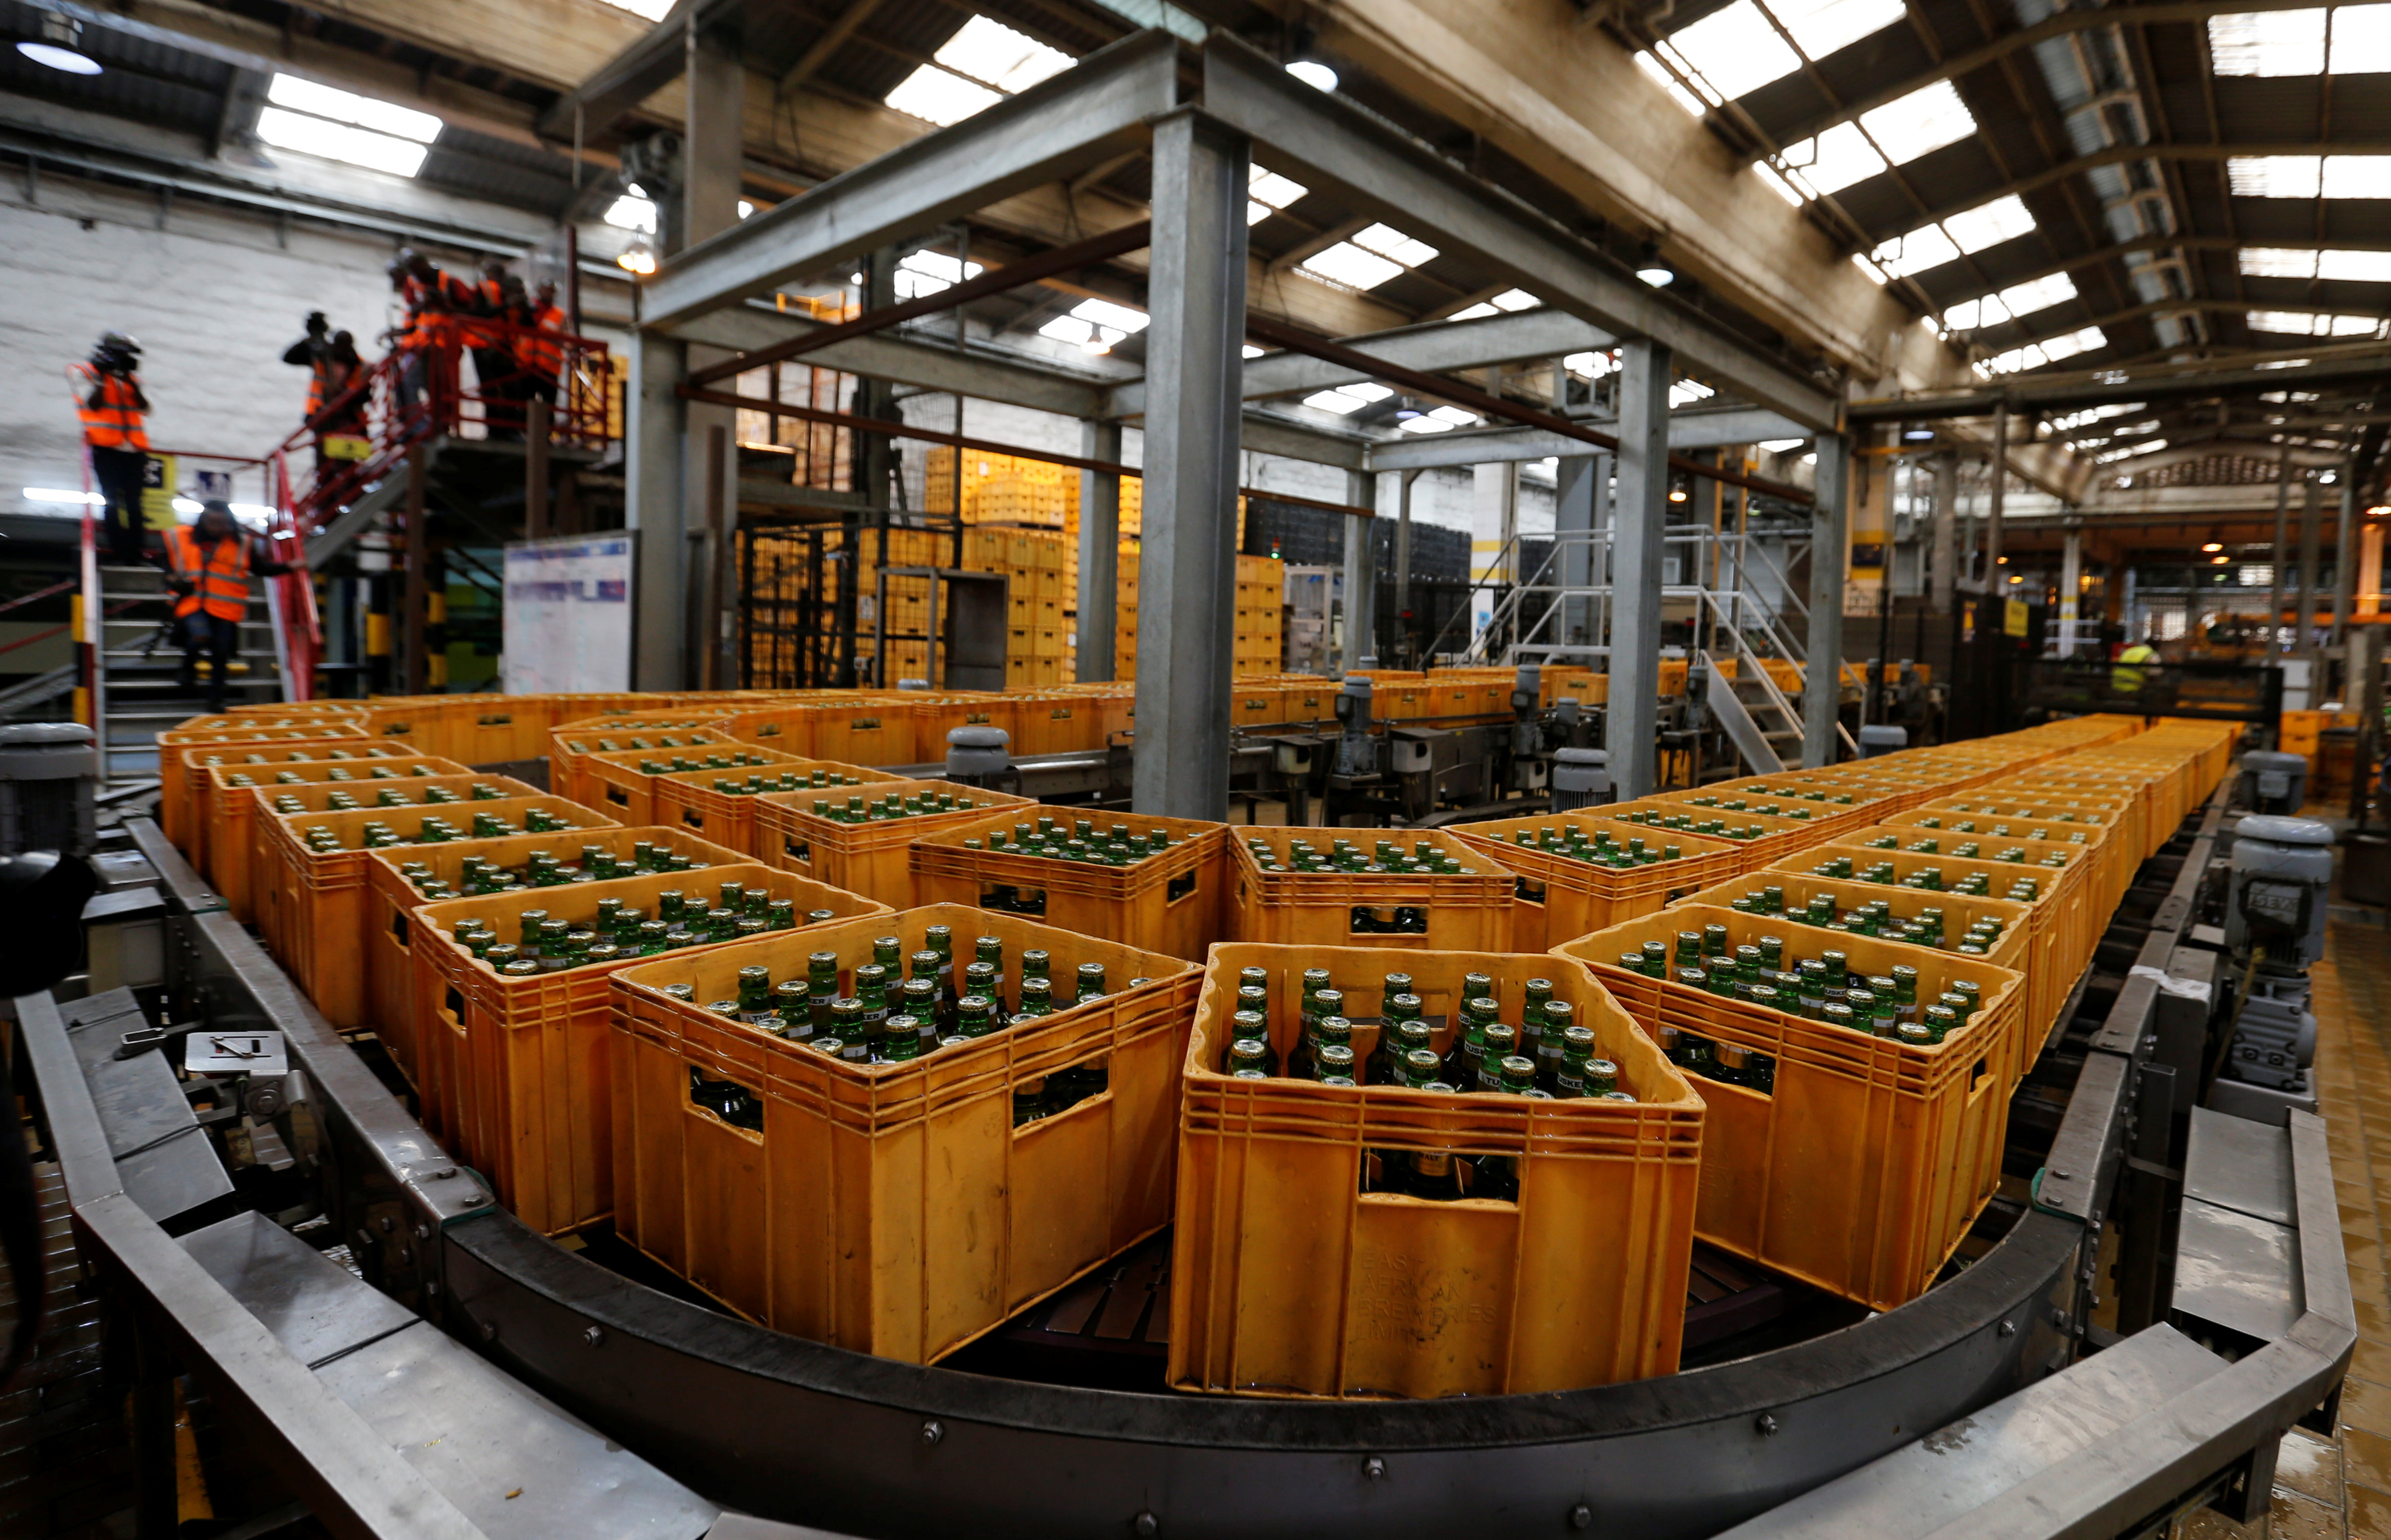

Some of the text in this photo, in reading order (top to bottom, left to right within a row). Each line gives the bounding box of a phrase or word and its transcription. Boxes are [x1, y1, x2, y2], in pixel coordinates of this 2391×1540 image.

[1418, 1151, 1440, 1162] MALT
[1362, 1252, 1424, 1275] EAST
[1360, 1274, 1460, 1302] AFRICAN
[1358, 1298, 1497, 1326] BREWERIES
[1356, 1321, 1447, 1351] LIMITED
